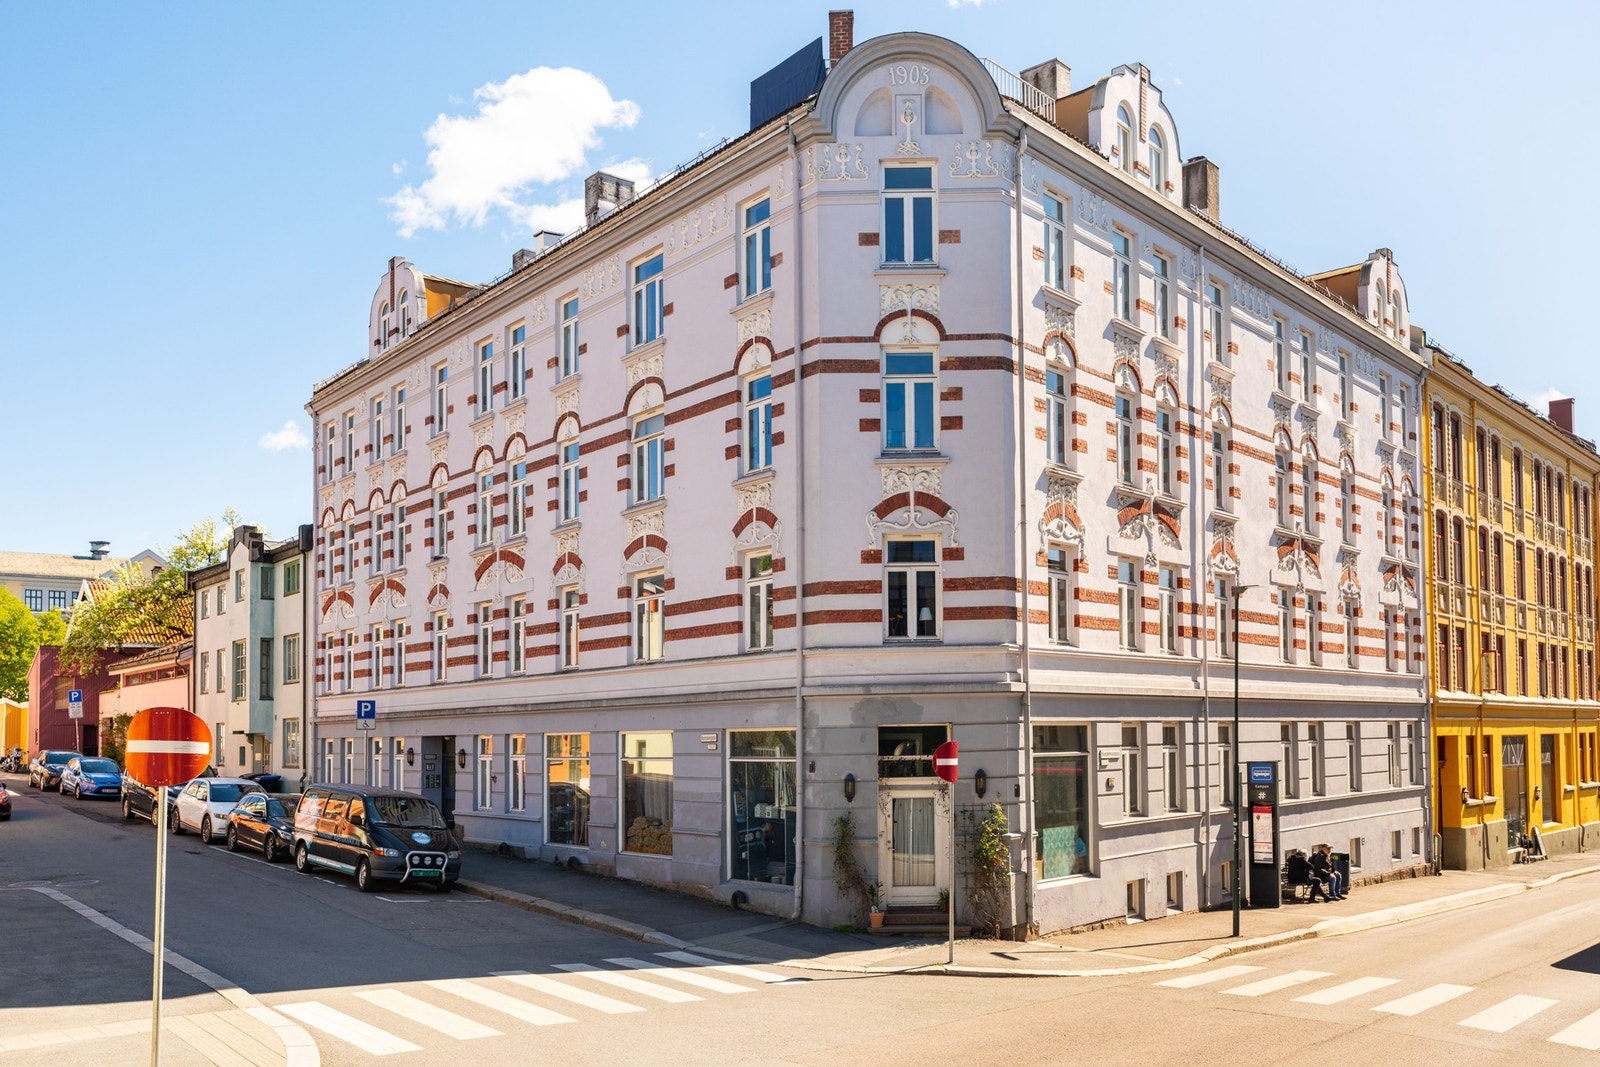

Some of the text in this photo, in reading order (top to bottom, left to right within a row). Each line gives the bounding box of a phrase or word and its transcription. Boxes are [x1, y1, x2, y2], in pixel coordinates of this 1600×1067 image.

[889, 65, 931, 85] 1903
[71, 691, 79, 701] P
[361, 702, 371, 717] P
